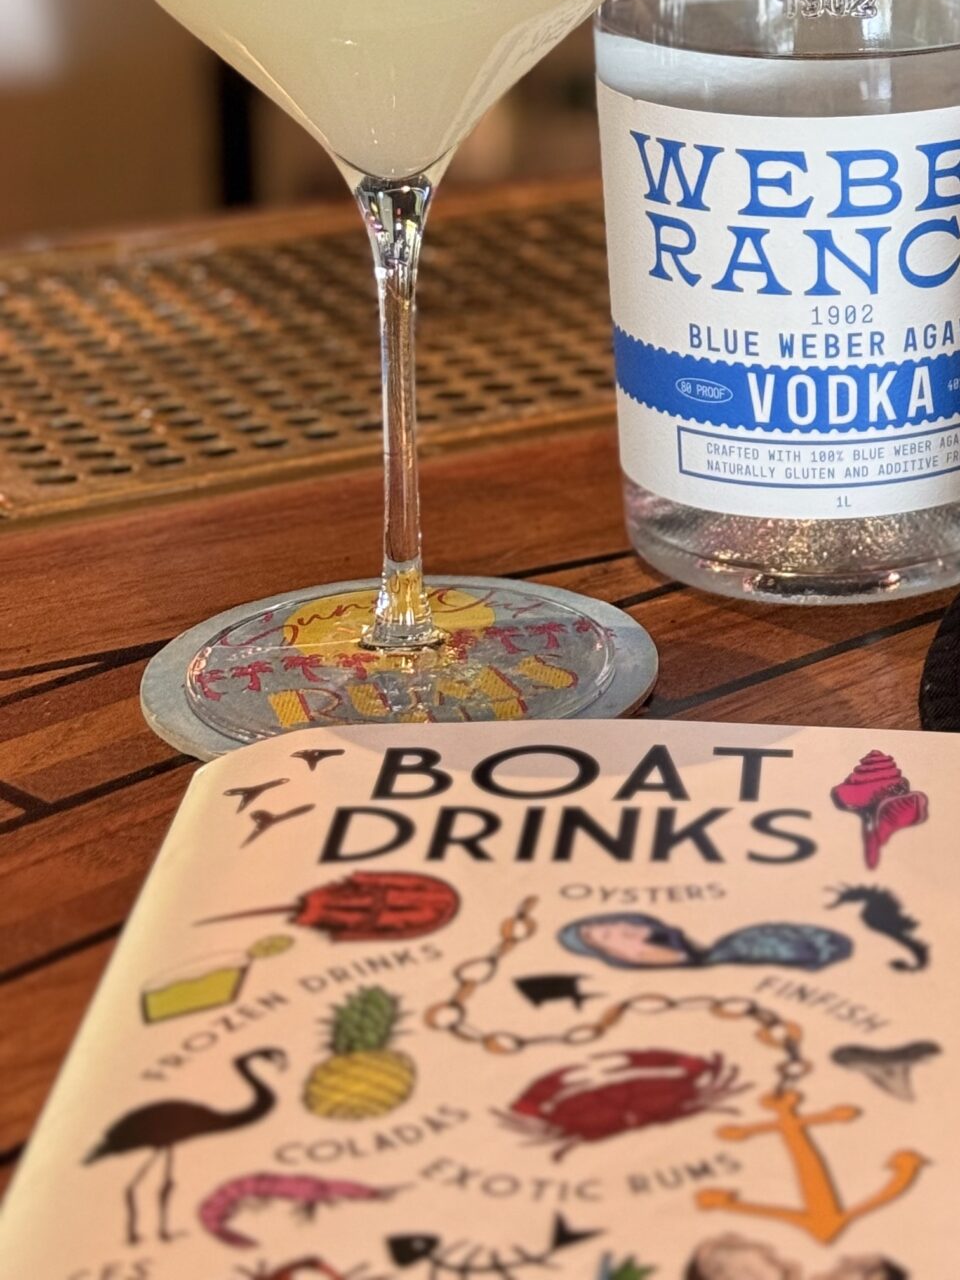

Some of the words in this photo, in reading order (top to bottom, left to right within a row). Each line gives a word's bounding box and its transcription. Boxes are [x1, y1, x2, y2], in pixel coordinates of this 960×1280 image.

[811, 304, 874, 325] 1902
[689, 323, 760, 357] BLUE
[779, 331, 885, 359] WEBER
[680, 381, 692, 394] 80
[696, 383, 726, 399] PROOF
[746, 365, 935, 426] VODKA
[706, 442, 760, 461] CRAFTED
[768, 449, 801, 462] WITH
[811, 450, 844, 463] 100%
[853, 447, 885, 461] BLUE
[894, 439, 932, 456] WEBER
[706, 460, 776, 479] NATURALLY
[785, 467, 836, 480] GLUTEN
[844, 466, 869, 479] AND
[878, 455, 939, 476] ADDITIVE
[836, 495, 852, 508] 1L
[369, 744, 794, 802] BOAT
[318, 805, 818, 865] DRINKS
[559, 883, 726, 904] OYSTERS
[141, 990, 289, 1083] FROZEN
[299, 943, 443, 994] DRINKS
[754, 976, 891, 1034] FINFISH
[274, 1105, 471, 1165] COLADAS
[420, 1157, 603, 1202] EXOTIC
[627, 1152, 743, 1194] RUMS
